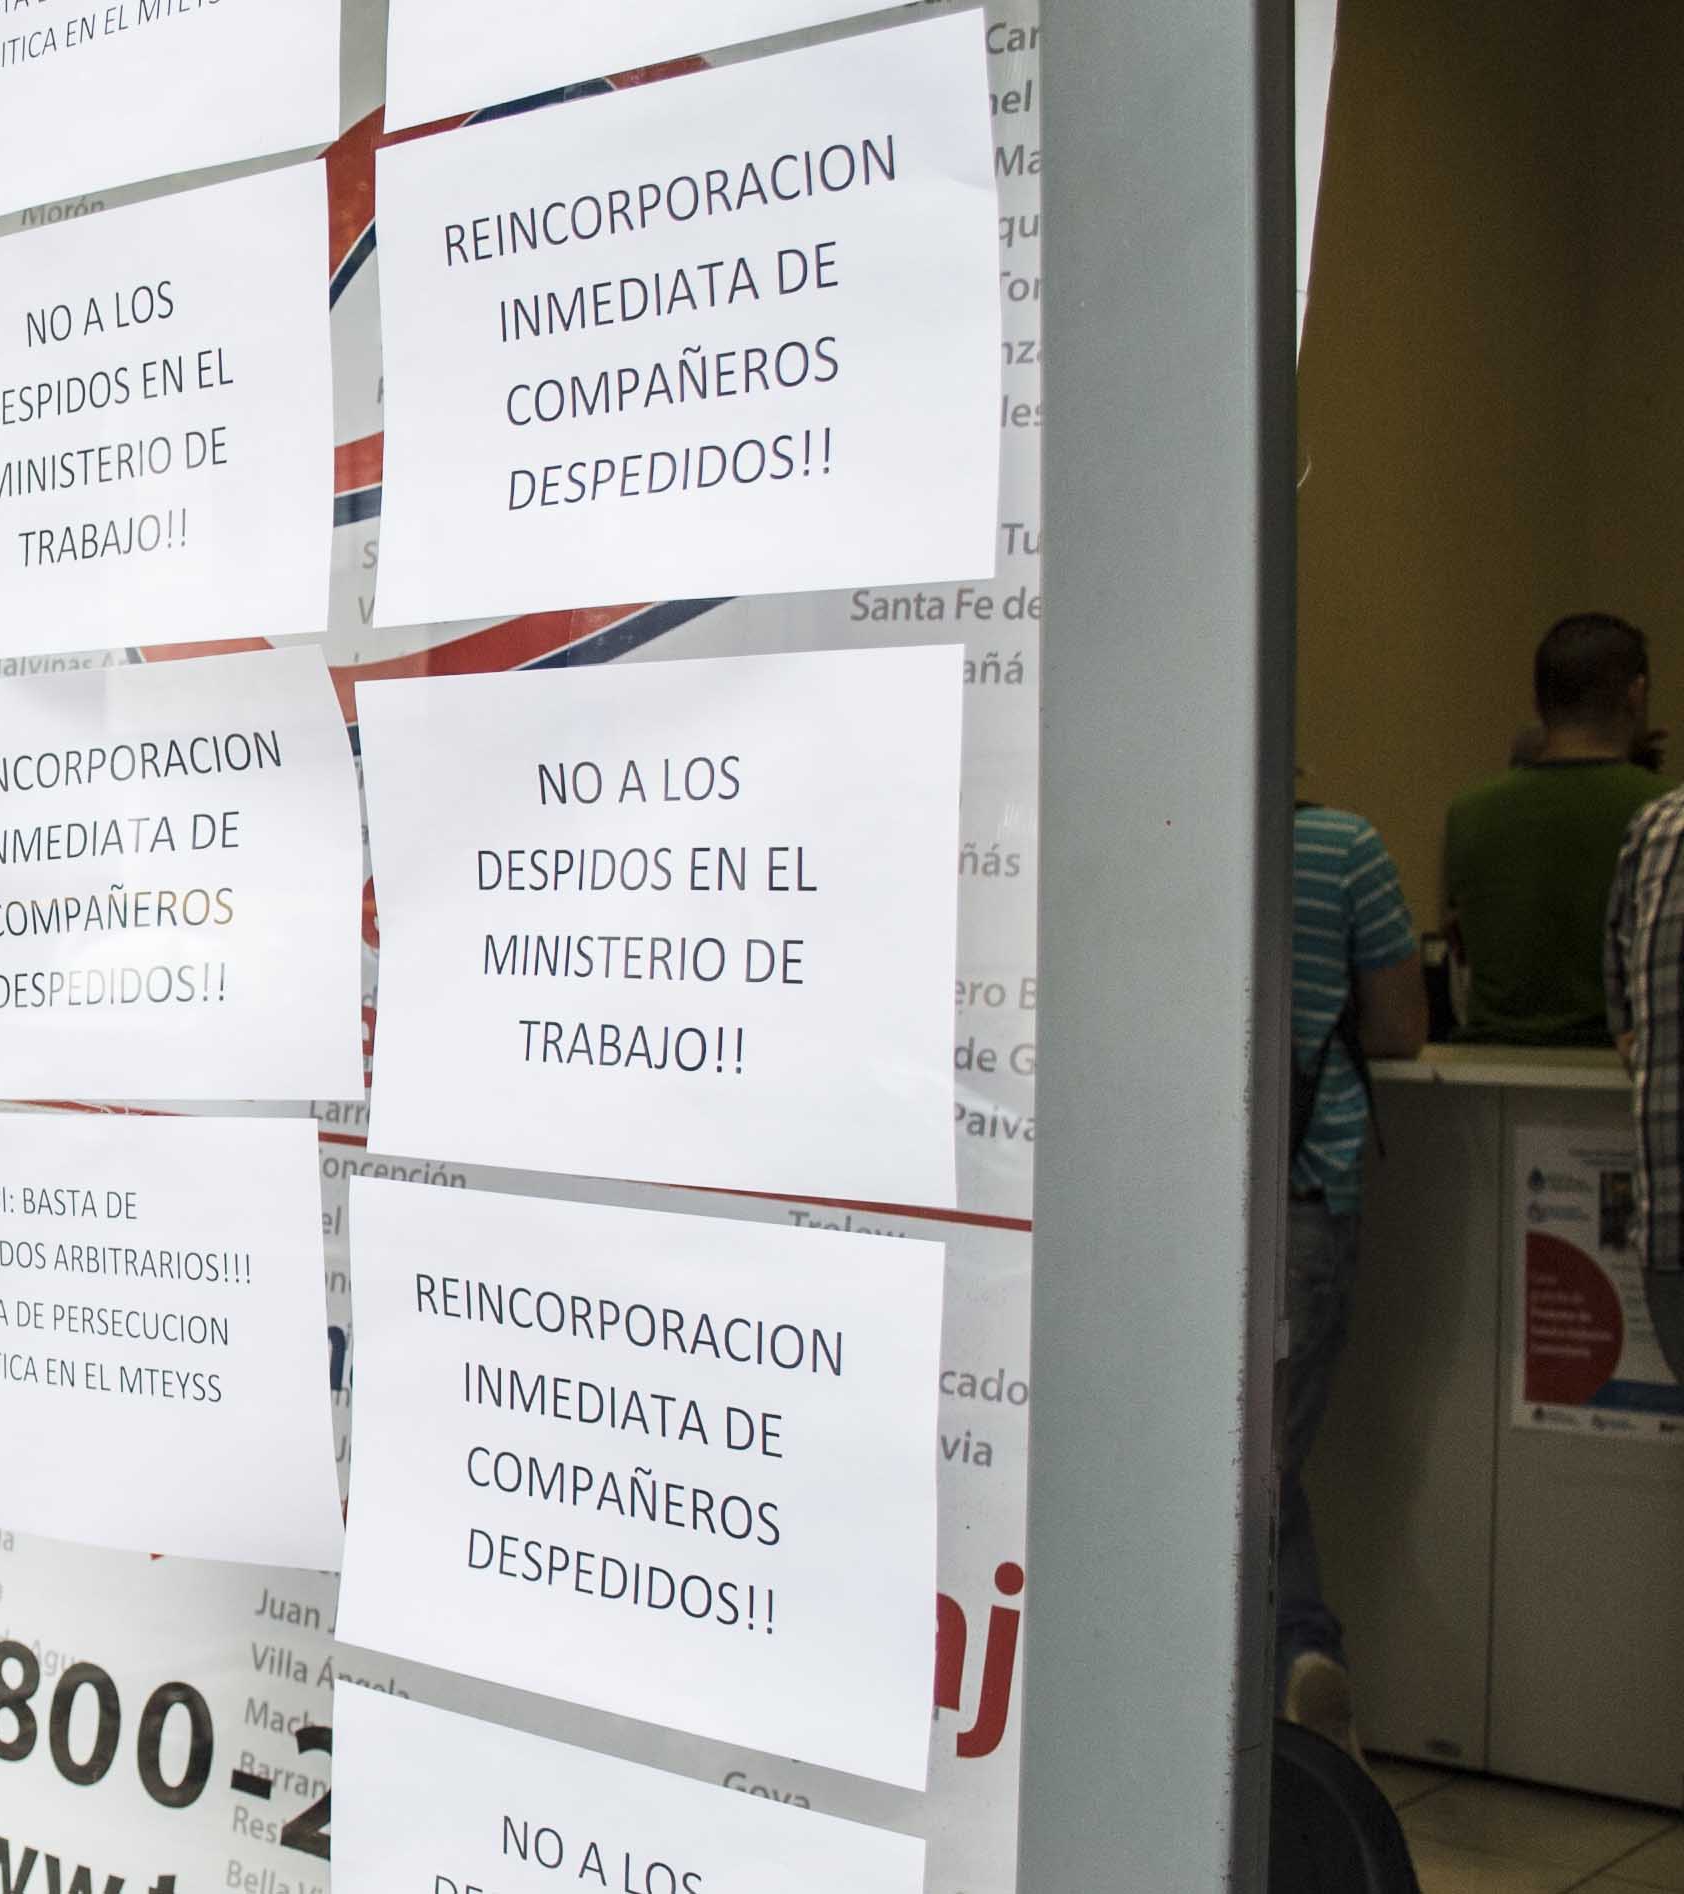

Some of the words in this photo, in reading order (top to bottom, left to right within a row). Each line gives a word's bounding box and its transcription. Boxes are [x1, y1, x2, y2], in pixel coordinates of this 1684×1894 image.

[66, 13, 96, 48] EN
[104, 4, 129, 35] EL
[445, 134, 895, 268] REINCORPORACION
[27, 304, 72, 348] NO
[84, 297, 104, 336] A
[116, 281, 173, 328] LOS
[500, 257, 760, 343] INMEDIATA
[777, 241, 839, 295] DE
[142, 355, 183, 400] EN
[198, 347, 234, 389] EL
[507, 336, 839, 426] COMPAÑEROS
[183, 426, 227, 470] DE
[509, 427, 830, 511] DESPEDIDOS!!
[18, 507, 186, 568] TRABAJO!!
[850, 589, 945, 621] Santa
[955, 587, 994, 620] Fe
[538, 761, 602, 805] NO
[618, 760, 647, 804] A
[663, 755, 740, 801] LOS
[191, 809, 240, 851] DE
[478, 847, 672, 891] DESPIDOS
[690, 846, 746, 891] EN
[768, 846, 817, 892] EL
[484, 934, 725, 982] MINISTERIO
[745, 939, 804, 984] DE
[519, 1020, 743, 1074] TRABAJO!!
[23, 1187, 98, 1218] BASTA
[106, 1191, 137, 1219] DE
[54, 1244, 250, 1284] ARBITRARIOS!!!
[17, 1300, 44, 1329] DE
[53, 1304, 228, 1346] PERSECUCION
[416, 1273, 842, 1376] REINCORPORACION
[46, 1358, 75, 1388] EN
[85, 1362, 111, 1391] EL
[120, 1365, 221, 1403] MTEYSS
[465, 1361, 708, 1445] INMEDIATA
[726, 1406, 783, 1459] DE
[468, 1446, 780, 1546] COMPAÑEROS
[468, 1528, 773, 1635] DESPEDIDOS!!
[254, 1588, 320, 1630] Juan
[251, 1642, 308, 1684] Villa
[503, 1815, 563, 1869] NO
[578, 1842, 607, 1887] A
